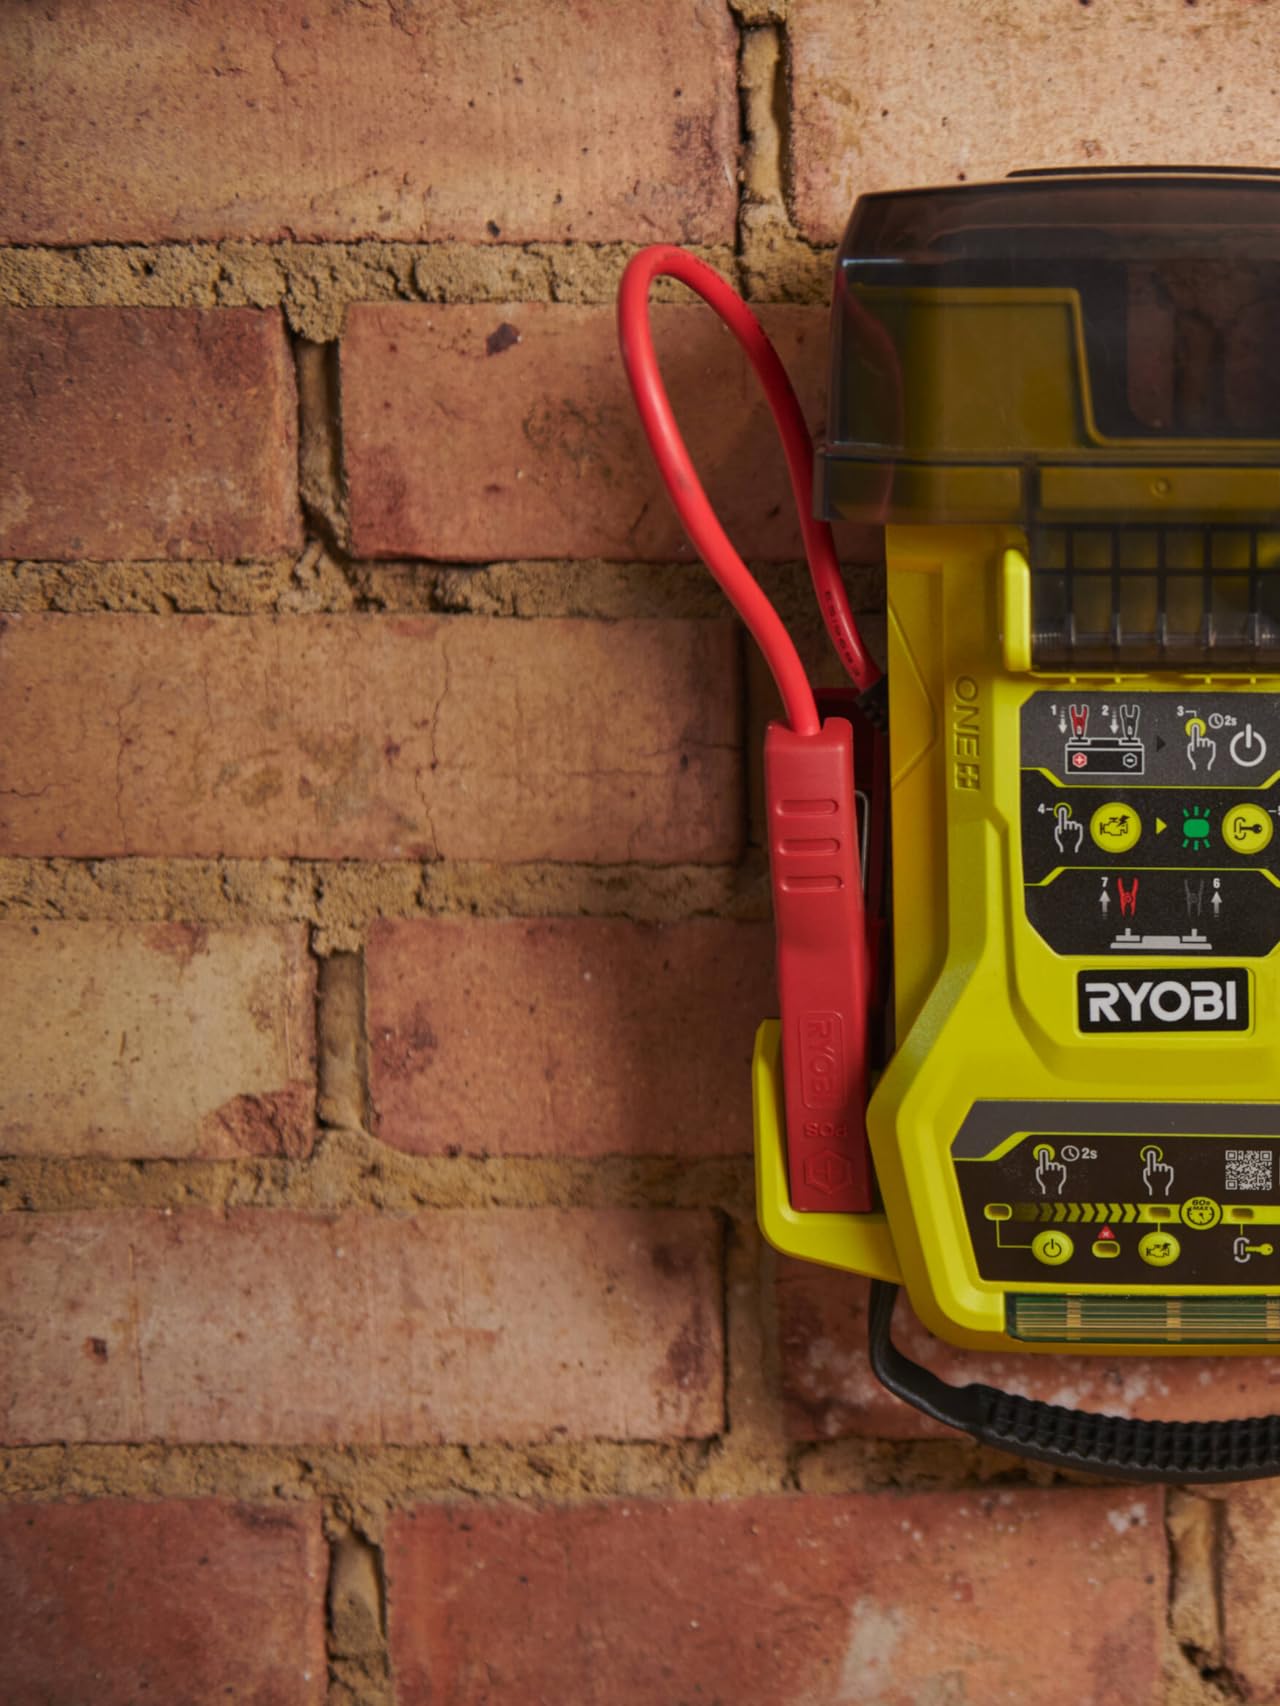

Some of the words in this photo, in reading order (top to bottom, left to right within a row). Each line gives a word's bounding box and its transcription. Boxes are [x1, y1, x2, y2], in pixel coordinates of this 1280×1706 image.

[1050, 704, 1057, 716] 1
[1101, 705, 1109, 716] 2
[1177, 705, 1184, 717] 3
[1224, 715, 1237, 726] 2s
[1037, 804, 1046, 814] 4
[1101, 877, 1109, 888] 7
[1212, 878, 1220, 889] 6
[1085, 980, 1237, 1022] RYOBI
[1081, 1147, 1098, 1159] 2s
